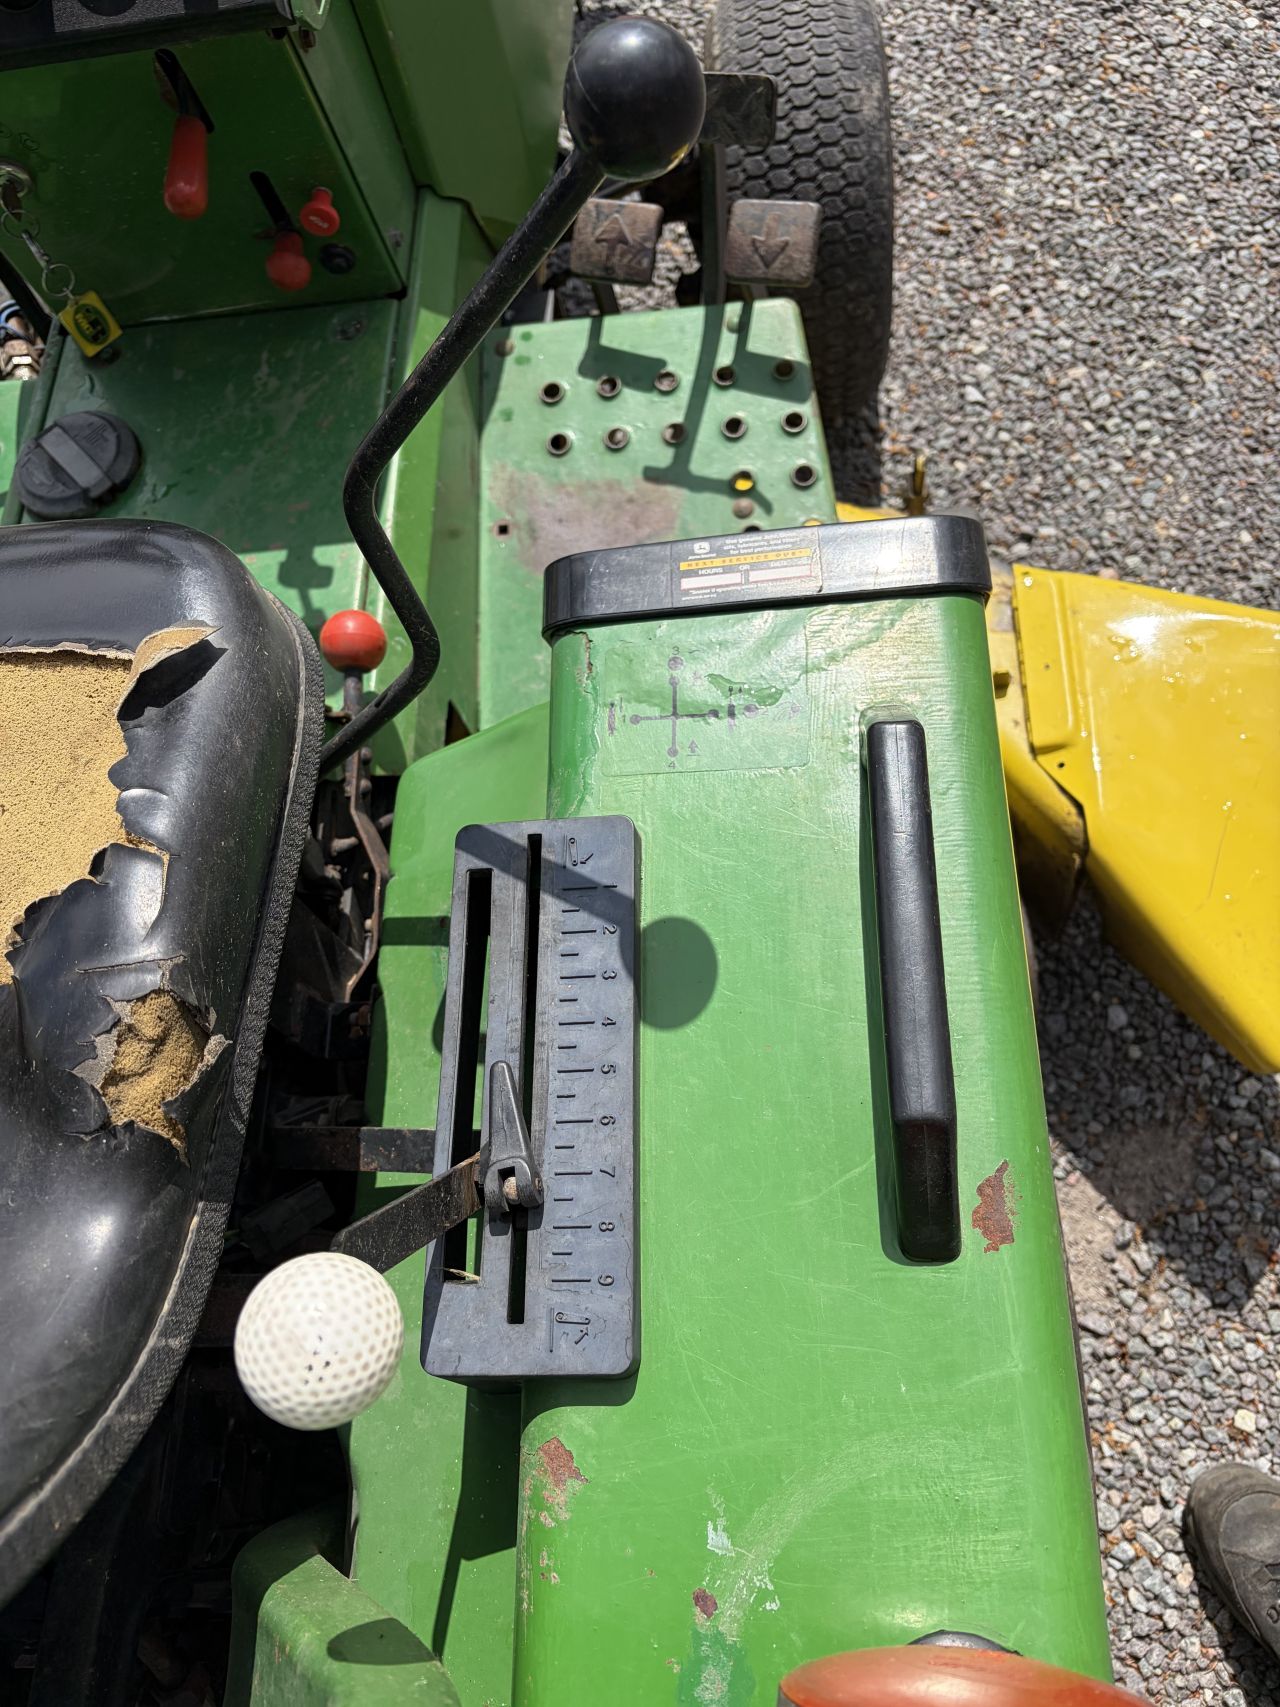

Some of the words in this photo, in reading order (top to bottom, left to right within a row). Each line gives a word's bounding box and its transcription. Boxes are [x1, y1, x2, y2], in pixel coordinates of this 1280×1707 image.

[698, 567, 723, 575] HOURS
[671, 646, 680, 656] 3
[602, 924, 618, 936] 2
[601, 970, 618, 981] 3
[601, 1016, 617, 1027] 4
[600, 1063, 617, 1075] 5
[600, 1115, 616, 1127] 6
[599, 1166, 616, 1178] 7
[598, 1221, 615, 1232] 8
[597, 1274, 615, 1287] 9
